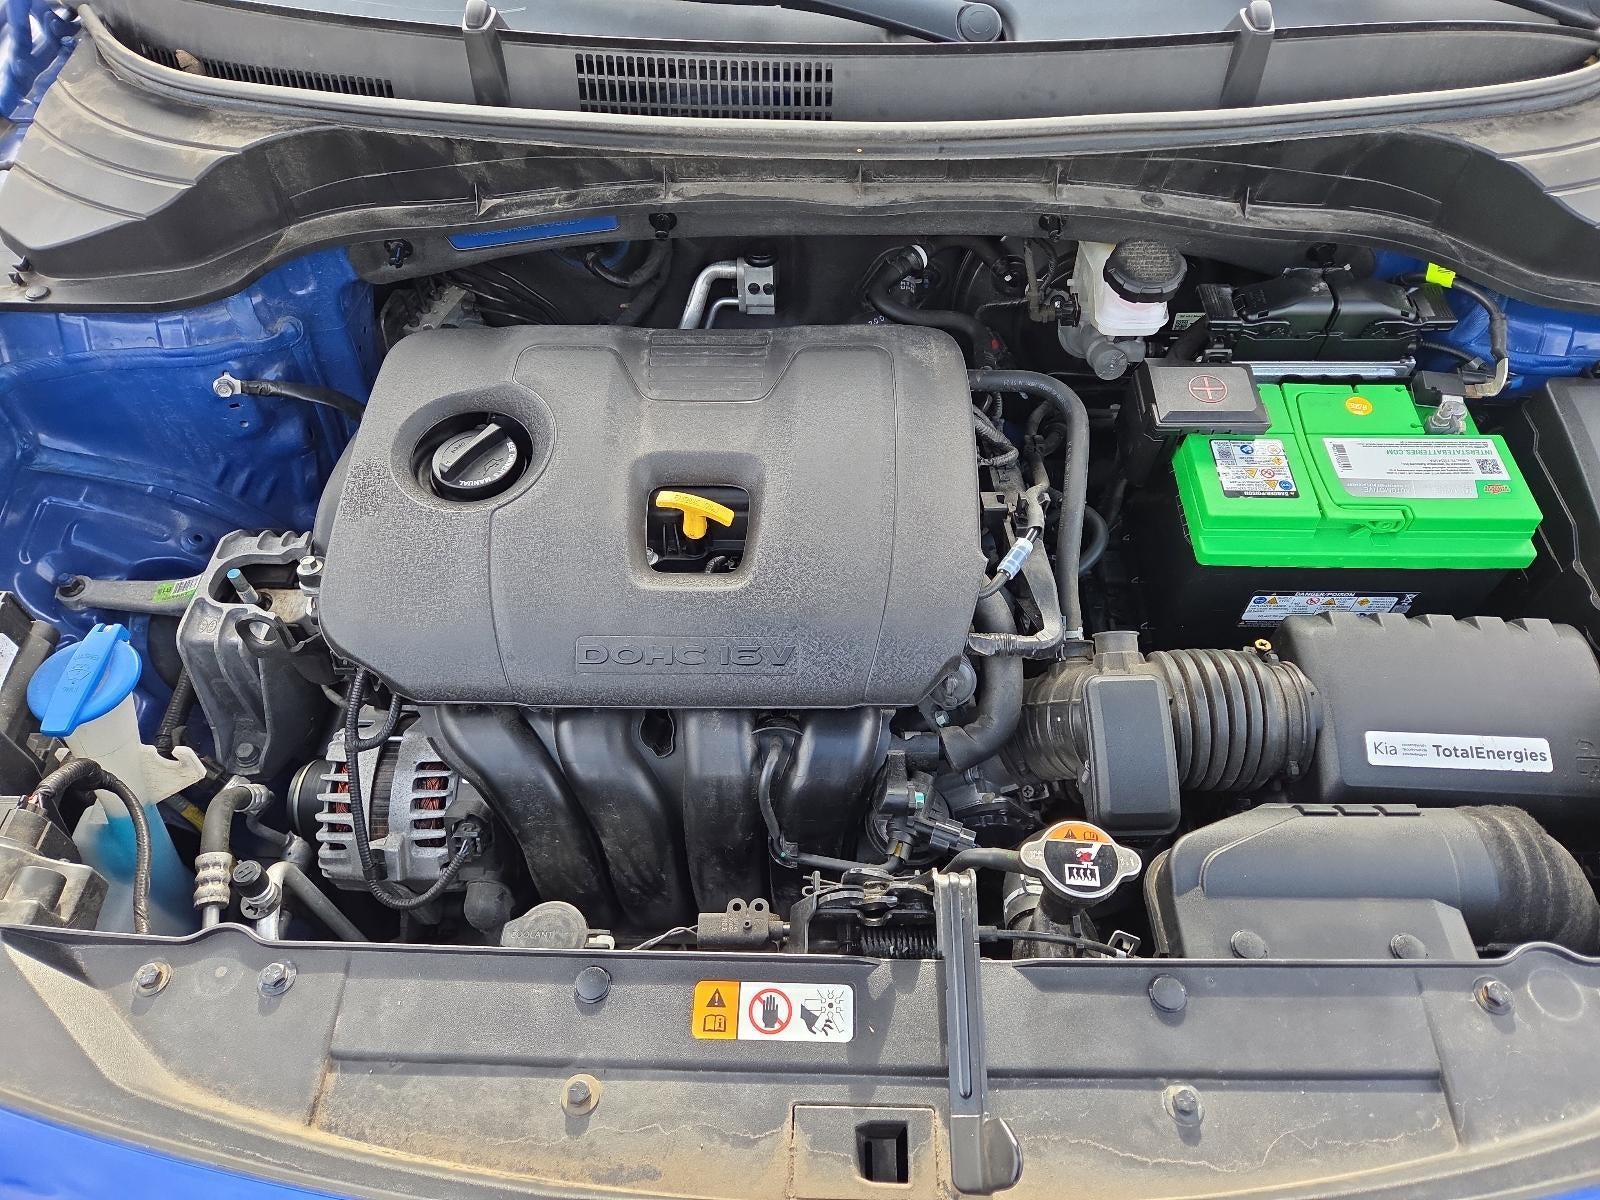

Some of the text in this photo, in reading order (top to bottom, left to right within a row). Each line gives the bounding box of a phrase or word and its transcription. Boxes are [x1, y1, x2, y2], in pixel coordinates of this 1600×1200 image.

[578, 644, 796, 667] DOHC 16V
[1373, 741, 1548, 763] Kia TotalEnergies
[511, 930, 553, 939] COOLANT
